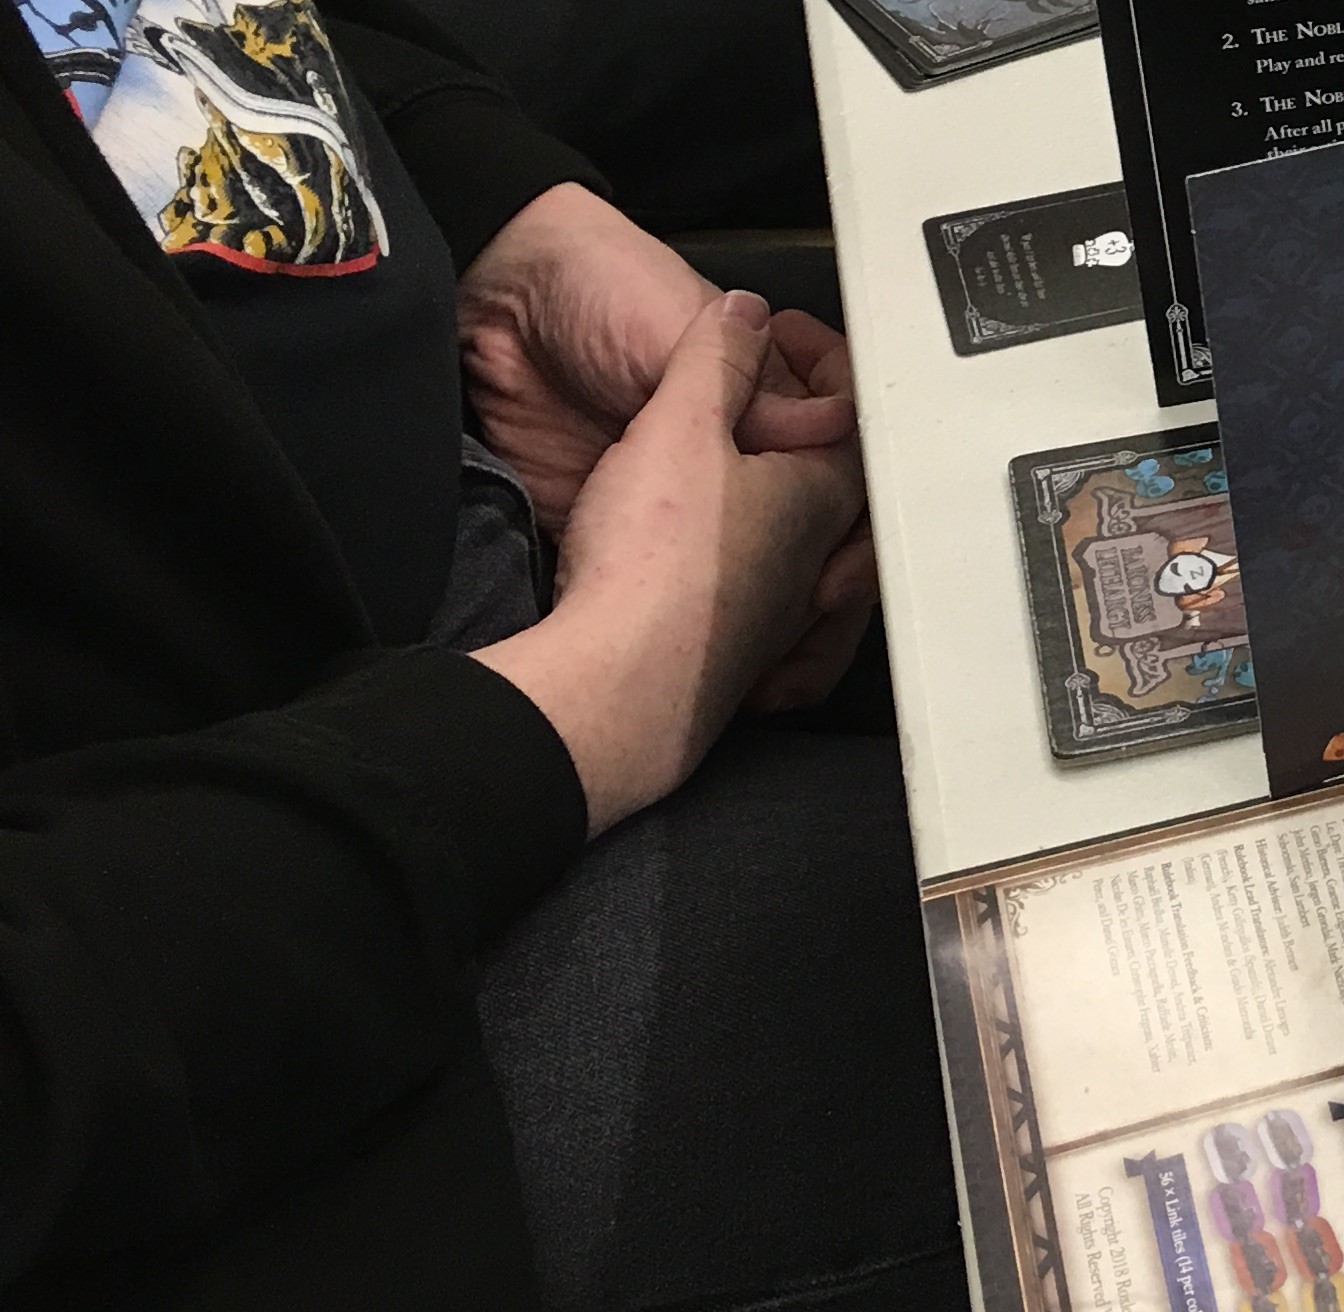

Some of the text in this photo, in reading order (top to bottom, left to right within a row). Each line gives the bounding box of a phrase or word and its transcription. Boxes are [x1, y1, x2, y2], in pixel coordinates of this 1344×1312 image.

[1220, 32, 1240, 50] 2.
[1249, 26, 1288, 45] THE
[1255, 57, 1291, 75] Play
[1294, 50, 1326, 69] and
[1230, 100, 1249, 118] 3.
[1258, 95, 1296, 113] THE
[1264, 123, 1309, 141] After
[1311, 117, 1333, 135] all
[1165, 1198, 1182, 1227] Link
[1074, 1192, 1109, 1309] All Rights Reserved
[1097, 1185, 1134, 1312] Copyright 2018 Roxle
[1168, 1228, 1186, 1255] tiles
[1176, 1274, 1194, 1294] per
